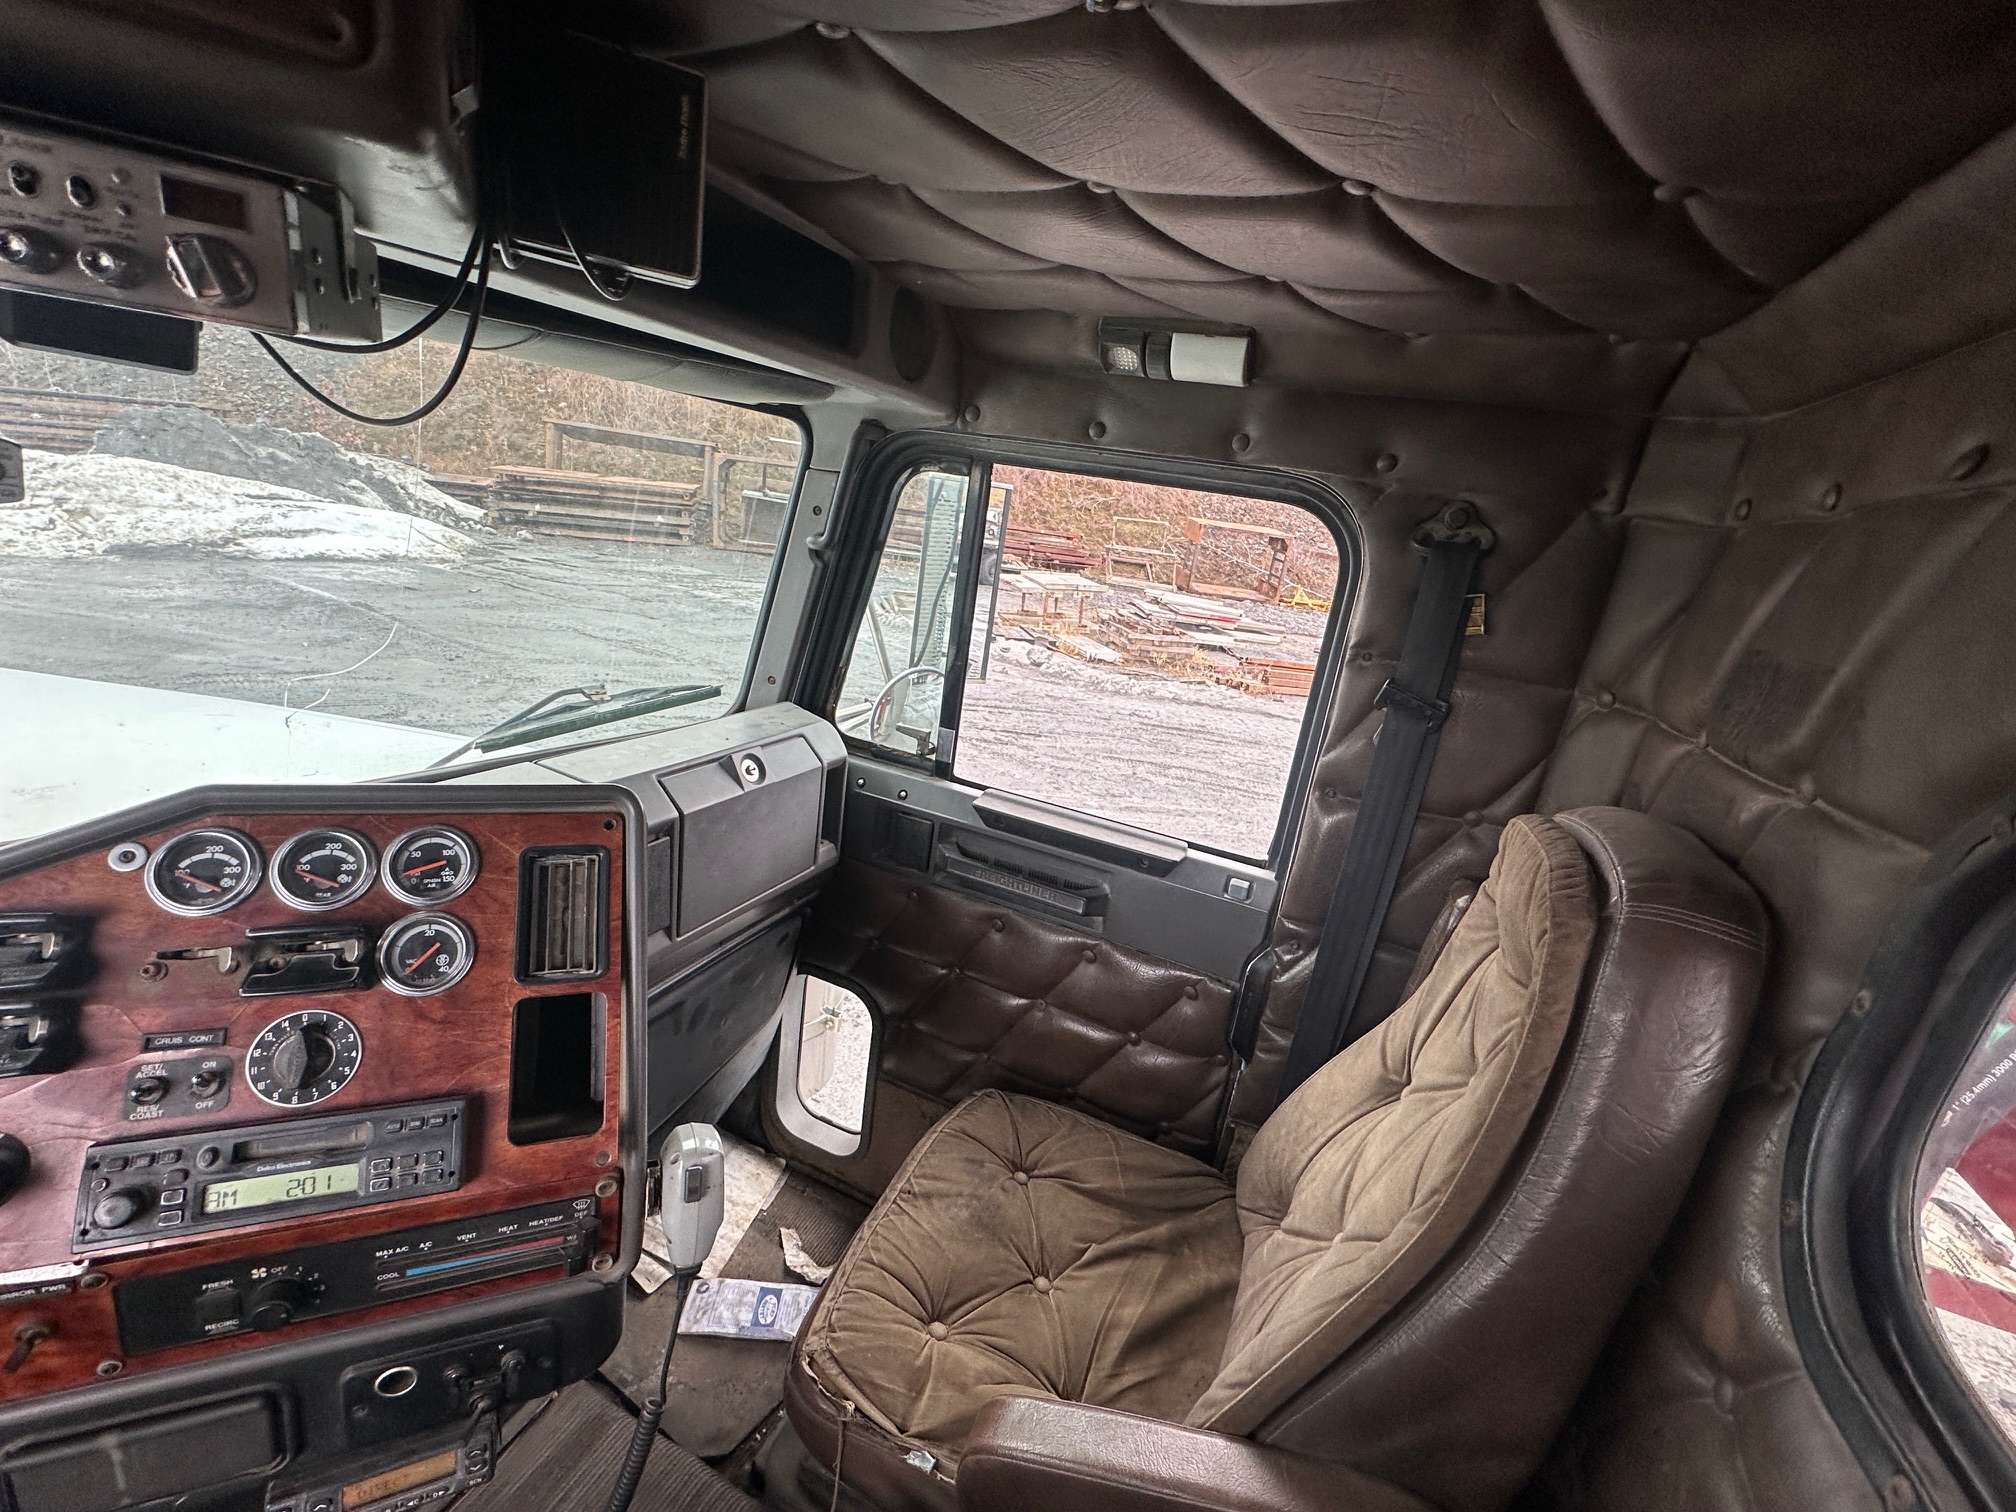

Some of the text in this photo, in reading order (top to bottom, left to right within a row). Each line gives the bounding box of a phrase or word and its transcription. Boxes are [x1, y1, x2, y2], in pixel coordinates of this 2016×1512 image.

[205, 845, 223, 853] 200
[410, 850, 422, 858] 50
[223, 866, 241, 874] 300
[340, 863, 357, 871] 300
[442, 875, 456, 883] 150
[302, 1013, 308, 1022] 0
[322, 1014, 327, 1022] 1
[281, 1020, 289, 1028] 14
[337, 1021, 344, 1029] 2
[154, 1034, 214, 1045] CRUIS CONT
[264, 1032, 273, 1041] 13
[347, 1033, 354, 1042] 3
[253, 1048, 261, 1057] 12
[350, 1049, 357, 1058] 4
[141, 1063, 164, 1072] SET/
[202, 1061, 217, 1069] ON
[135, 1069, 168, 1079] ACCEL
[250, 1066, 258, 1075] 11
[344, 1066, 350, 1075] 5
[257, 1081, 265, 1090] 10
[330, 1081, 337, 1090] 6
[1960, 1073, 1997, 1106] (25.4mm)
[1991, 1058, 2013, 1077] 3000
[272, 1092, 279, 1101] 9
[312, 1091, 319, 1100] 7
[195, 1100, 214, 1109] OFF
[291, 1096, 298, 1105] 8
[136, 1105, 160, 1113] RES/
[129, 1110, 164, 1120] COAST
[276, 1160, 311, 1169] Electronics
[208, 1189, 238, 1208] AM
[574, 1210, 589, 1218] DEF
[498, 1224, 519, 1233] HEAT
[457, 1233, 477, 1241] VENT
[419, 1241, 433, 1249] A/C
[375, 1245, 410, 1257] MAX A/C
[270, 1265, 288, 1274] OFF
[376, 1272, 400, 1281] COOL
[41, 1283, 66, 1293] PWR
[202, 1279, 234, 1290] FRESH
[204, 1318, 239, 1331] RECIRC
